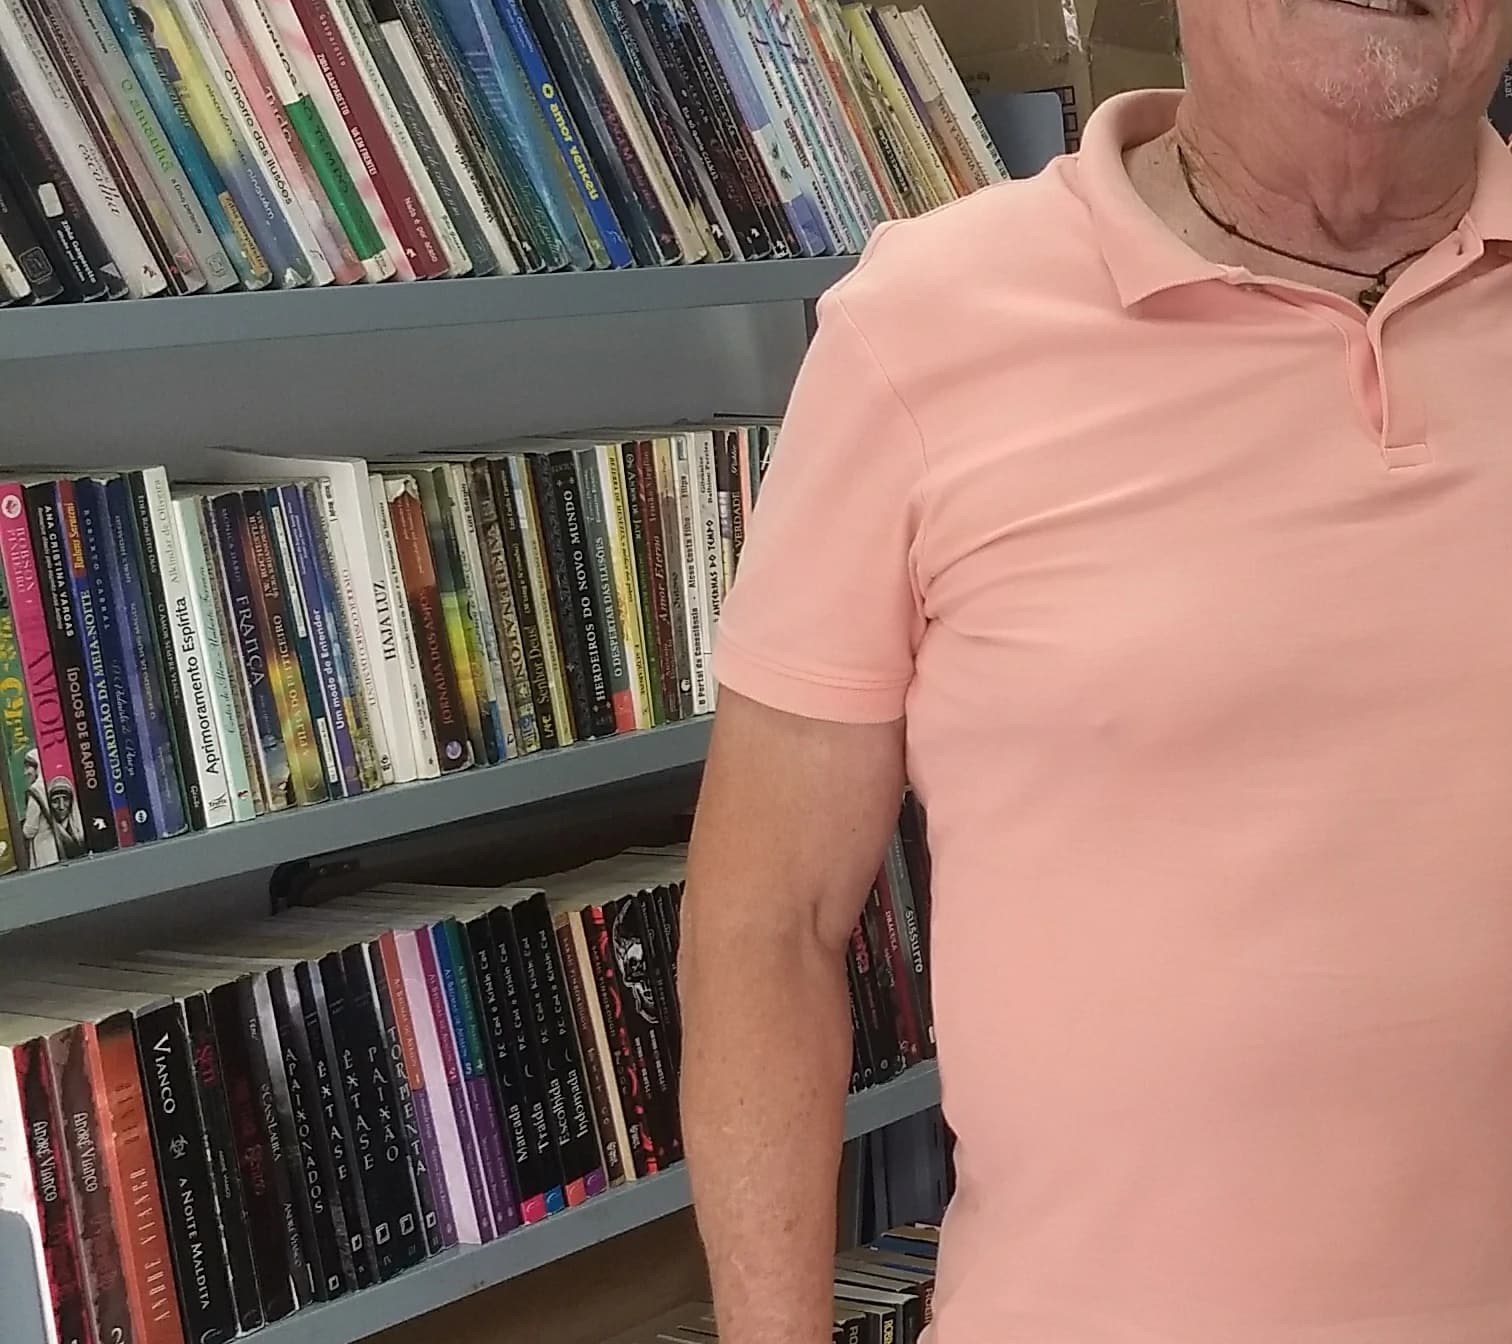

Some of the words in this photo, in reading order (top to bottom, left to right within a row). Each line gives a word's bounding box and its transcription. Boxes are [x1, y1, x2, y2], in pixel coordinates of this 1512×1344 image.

[542, 83, 554, 99] O
[549, 103, 570, 143] amor
[569, 145, 600, 201] venceu
[563, 489, 581, 545] MUNDO
[44, 506, 56, 531] ANA
[50, 533, 66, 590] CRISTINA
[60, 592, 75, 638] VARGAS
[573, 550, 590, 591] NOVO
[176, 596, 195, 652] Espírita
[579, 596, 595, 622] DO
[584, 623, 607, 701] HERDEIROS
[76, 721, 87, 740] DE
[188, 656, 221, 775] Aprimoramento
[79, 742, 98, 790] BARRO
[152, 1032, 177, 1116] VIANCO
[567, 1069, 588, 1139] Indomada
[509, 1103, 529, 1163] Marcada
[533, 1102, 550, 1154] Traída
[550, 1078, 570, 1147] Escolhida
